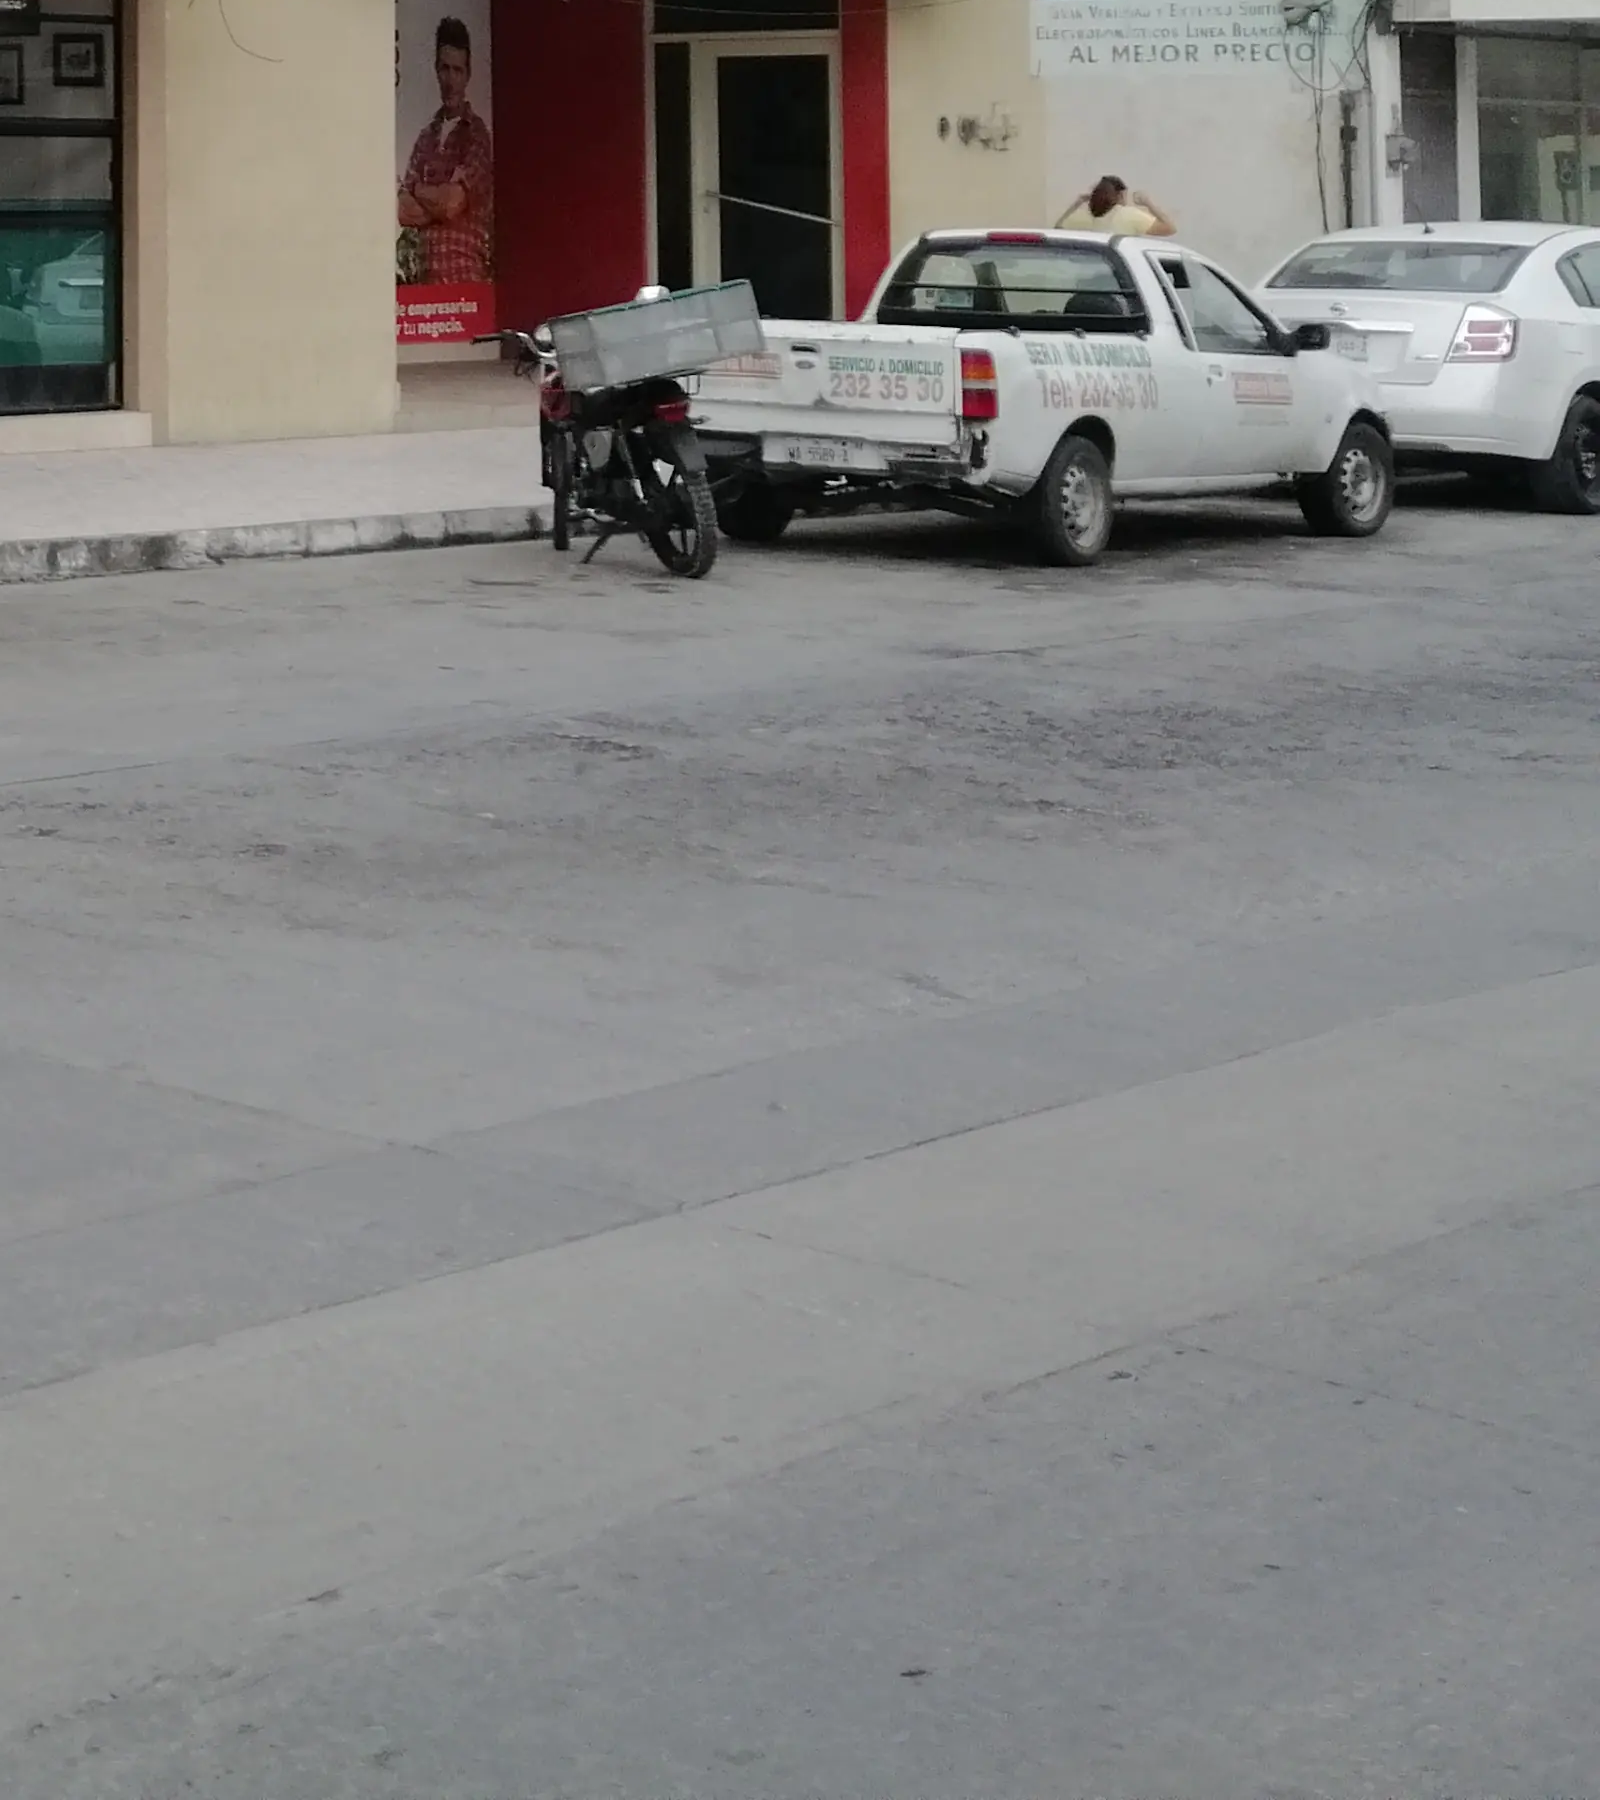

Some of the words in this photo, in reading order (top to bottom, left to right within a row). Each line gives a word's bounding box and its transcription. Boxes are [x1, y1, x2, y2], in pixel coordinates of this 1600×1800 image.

[1068, 44, 1100, 65] AL
[1111, 42, 1200, 64] MEJOR
[1213, 41, 1318, 65] PRECIO
[828, 355, 876, 373] SERVICIO
[887, 358, 945, 377] DOMICILIO
[829, 372, 872, 399] 232
[878, 373, 908, 401] 35
